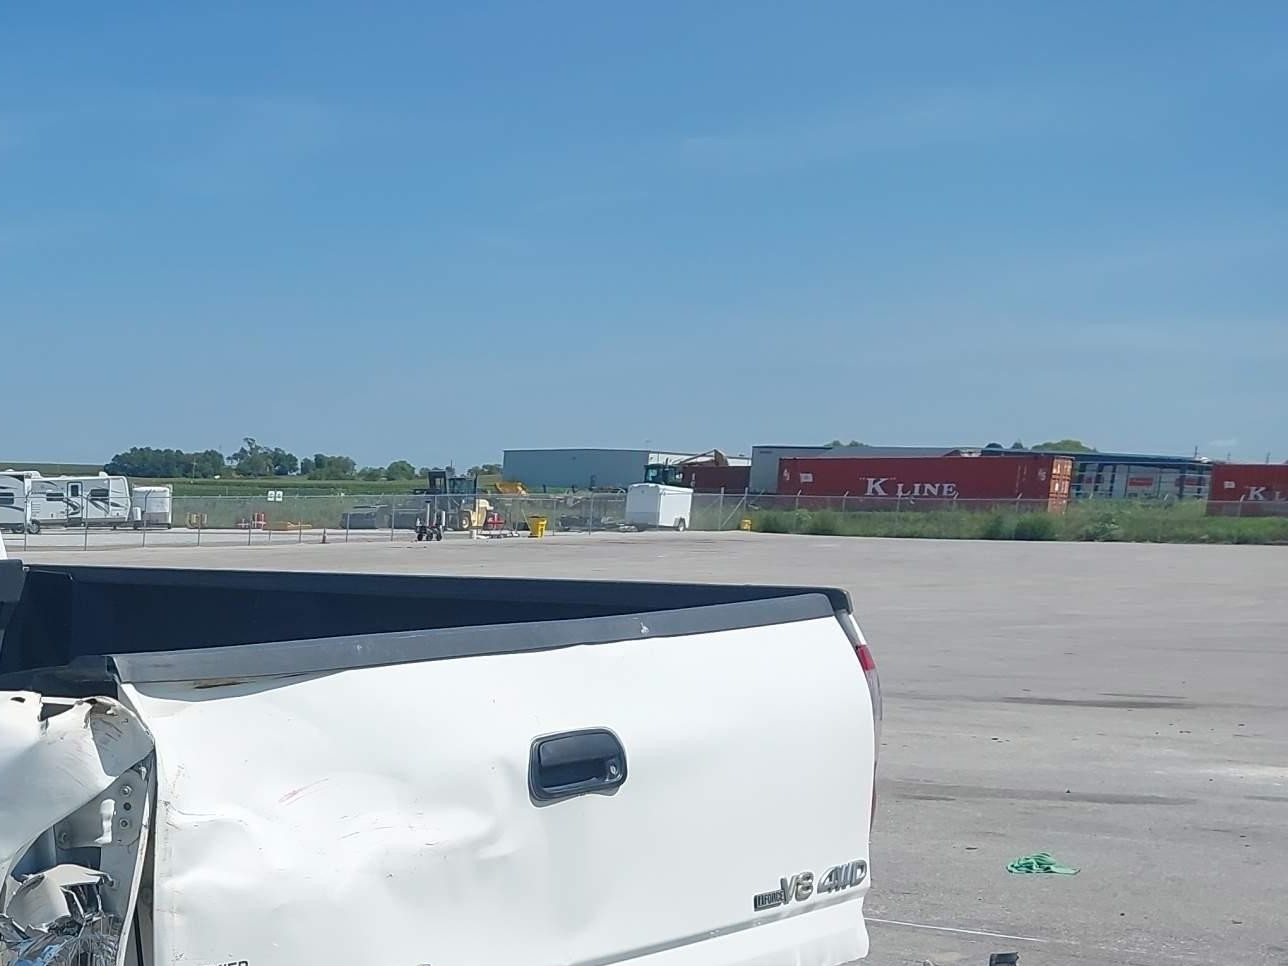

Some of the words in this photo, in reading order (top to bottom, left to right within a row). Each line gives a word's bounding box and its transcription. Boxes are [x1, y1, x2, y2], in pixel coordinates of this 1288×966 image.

[896, 483, 957, 497] LINE
[780, 871, 814, 905] V8
[816, 859, 868, 894] 4WD
